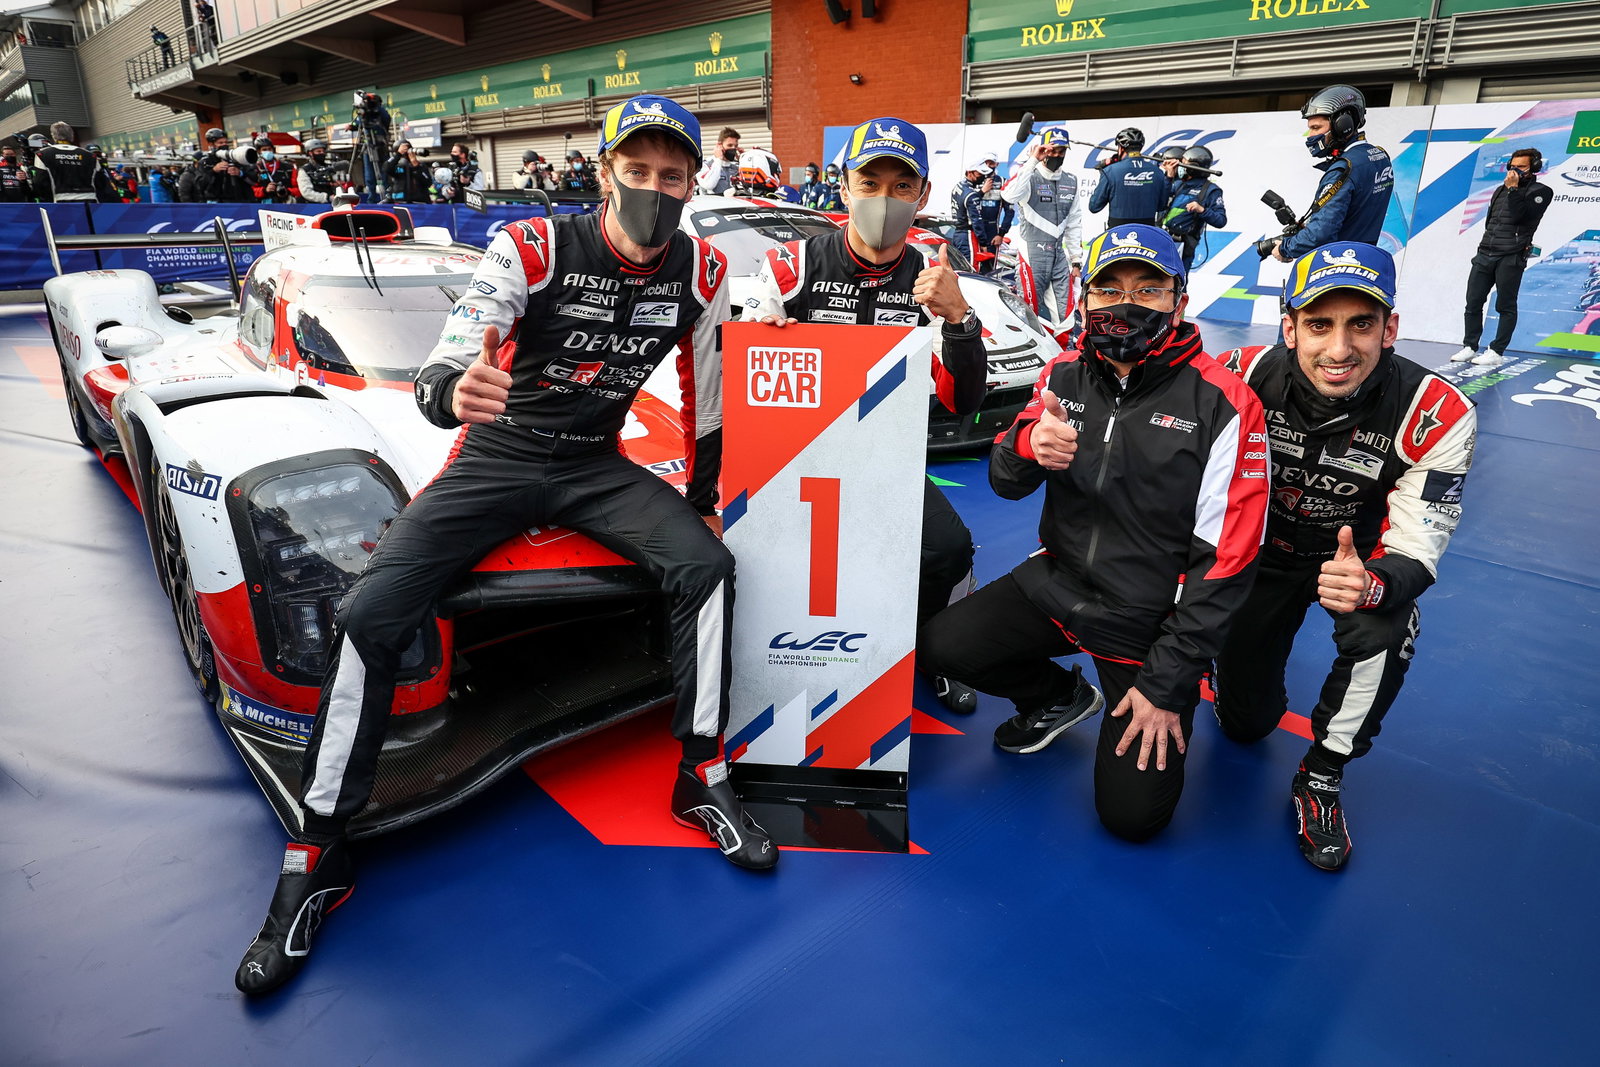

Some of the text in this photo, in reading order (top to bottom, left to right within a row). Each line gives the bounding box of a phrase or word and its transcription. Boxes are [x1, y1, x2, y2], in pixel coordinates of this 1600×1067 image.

[1249, 0, 1370, 21] ROLEX
[1021, 17, 1106, 47] ROLEX
[694, 56, 739, 77] ROLEX
[605, 71, 641, 89] ROLEX
[533, 83, 563, 99] ROLEX
[474, 93, 499, 107] ROLEX
[862, 140, 916, 156] MICHELIN
[1132, 160, 1143, 169] TV
[1081, 179, 1097, 187] FIA
[1124, 171, 1155, 181] WEC
[466, 192, 482, 206] BOSS
[267, 214, 294, 231] RACING
[724, 210, 829, 224] PORSCHE
[146, 254, 218, 263] CHAMPIONSHIP
[1098, 247, 1157, 263] MICHELIN
[563, 273, 621, 293] AISIN
[1309, 266, 1379, 284] MICHELIN
[812, 281, 861, 297] AISIN
[580, 291, 619, 308] ZENT
[828, 296, 859, 310] ZENT
[877, 291, 909, 305] Mobil
[571, 308, 610, 319] MICHELIN
[635, 303, 675, 317] WEC
[821, 313, 853, 321] MICHELIN
[878, 312, 916, 324] WEC
[563, 330, 661, 357] DENSO
[751, 350, 817, 372] HYPER
[1005, 357, 1041, 370] MICHELIN
[544, 366, 596, 384] GR
[750, 371, 817, 404] CAR
[1149, 415, 1174, 429] GR
[1269, 424, 1307, 444] ZENT
[1353, 429, 1376, 446] bil
[1243, 451, 1267, 460] RAY
[1270, 442, 1299, 454] ICHELIN
[167, 465, 221, 498] AISIN
[800, 477, 840, 617] 1
[768, 630, 868, 653] WEC
[768, 660, 828, 668] CHAMPIONSHIP
[812, 656, 859, 664] ENDURANCE
[245, 705, 312, 733] MICHEL
